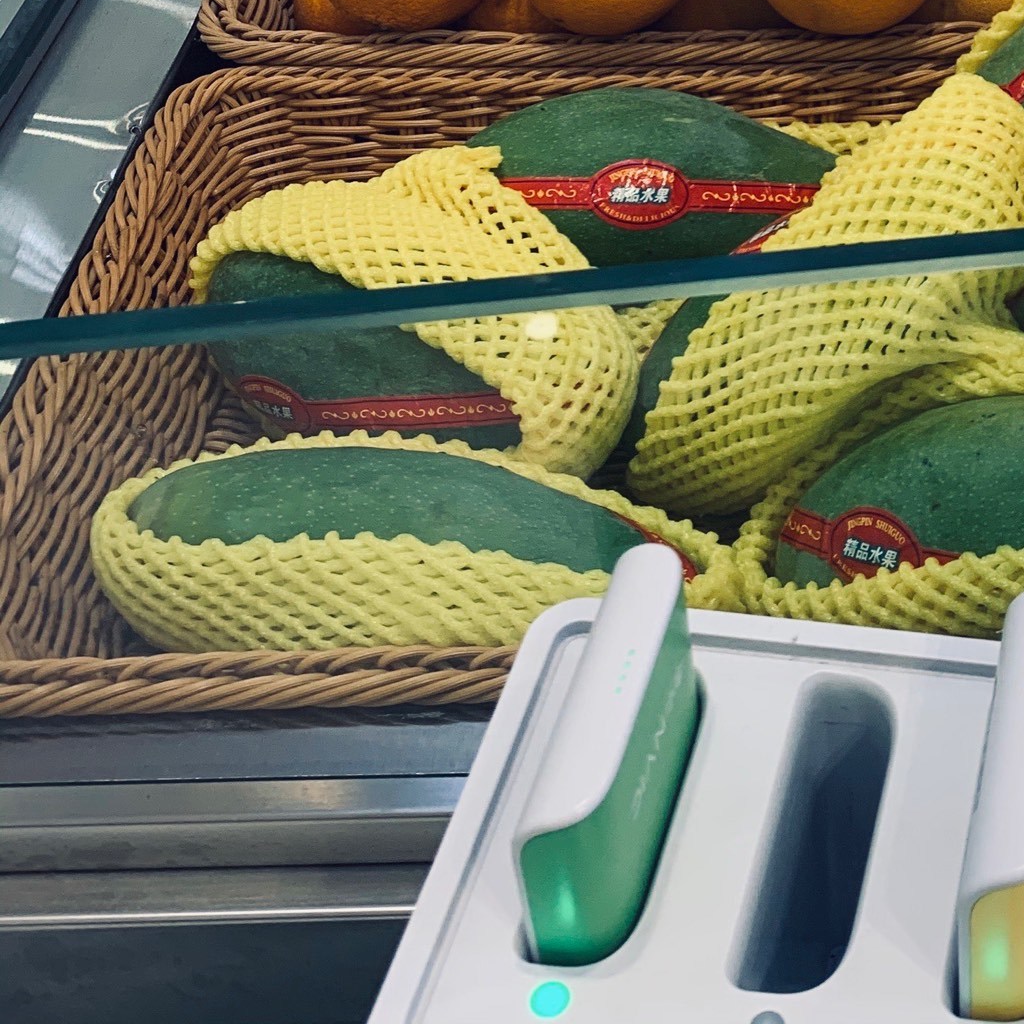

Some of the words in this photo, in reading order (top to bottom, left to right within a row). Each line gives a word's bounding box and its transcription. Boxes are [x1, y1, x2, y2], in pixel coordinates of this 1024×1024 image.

[875, 518, 907, 546] SHUIGUO
[842, 537, 899, 568] 精品水果
